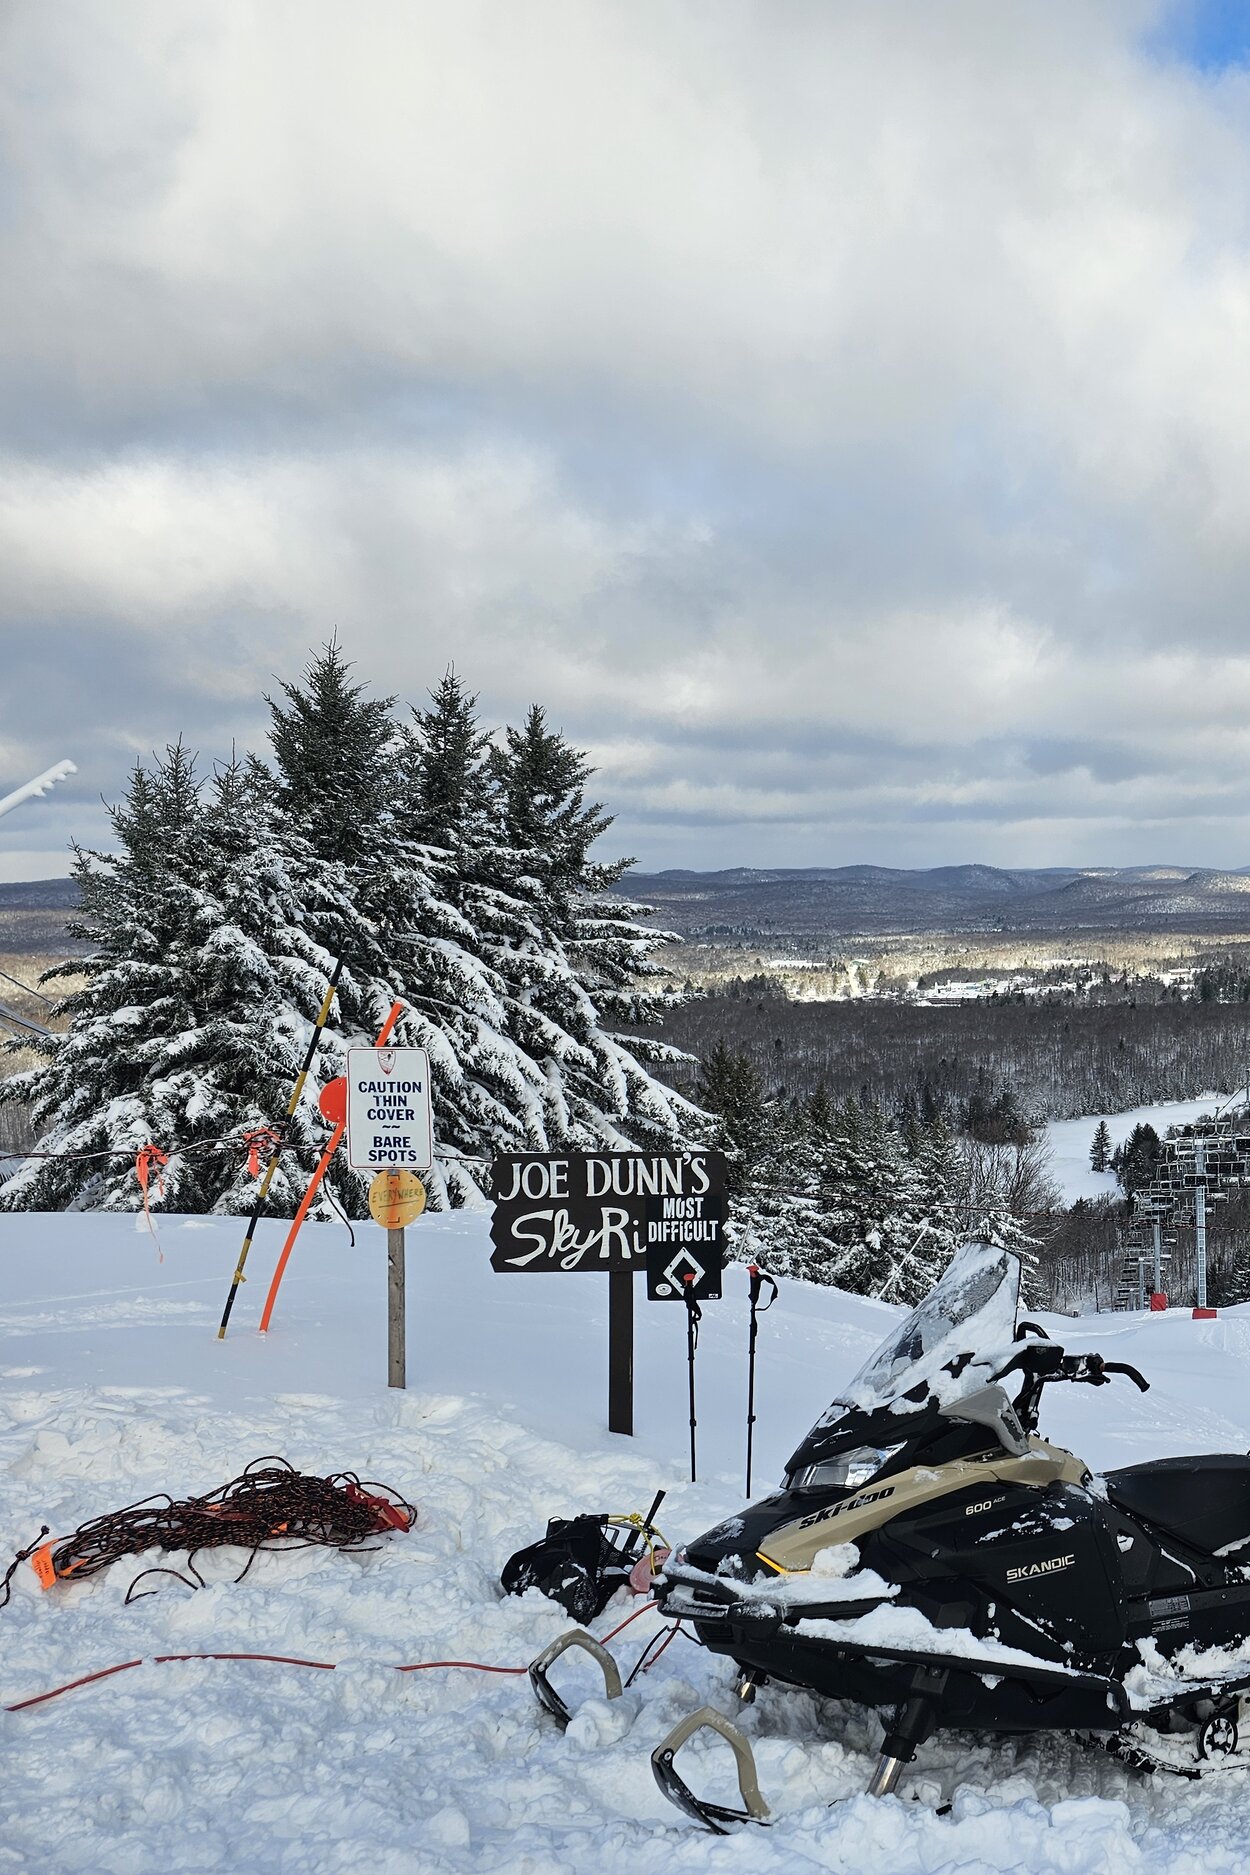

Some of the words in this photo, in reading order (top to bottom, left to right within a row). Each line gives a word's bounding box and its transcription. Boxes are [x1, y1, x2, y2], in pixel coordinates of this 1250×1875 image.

[358, 1081, 422, 1093] CAUTION
[373, 1095, 407, 1107] THIN
[367, 1108, 415, 1121] COVER
[373, 1136, 411, 1148] BARE
[368, 1149, 417, 1162] SPOTS
[498, 1160, 570, 1201] JOE
[585, 1152, 711, 1197] DUNN'S
[372, 1187, 424, 1203] EVERYWHERE
[662, 1197, 704, 1219] MOST
[503, 1206, 647, 1270] SkyRi
[648, 1220, 719, 1243] DIFFICULT
[965, 1500, 992, 1516] 600
[992, 1495, 1006, 1504] ACE
[1006, 1554, 1076, 1581] SKANDIC
